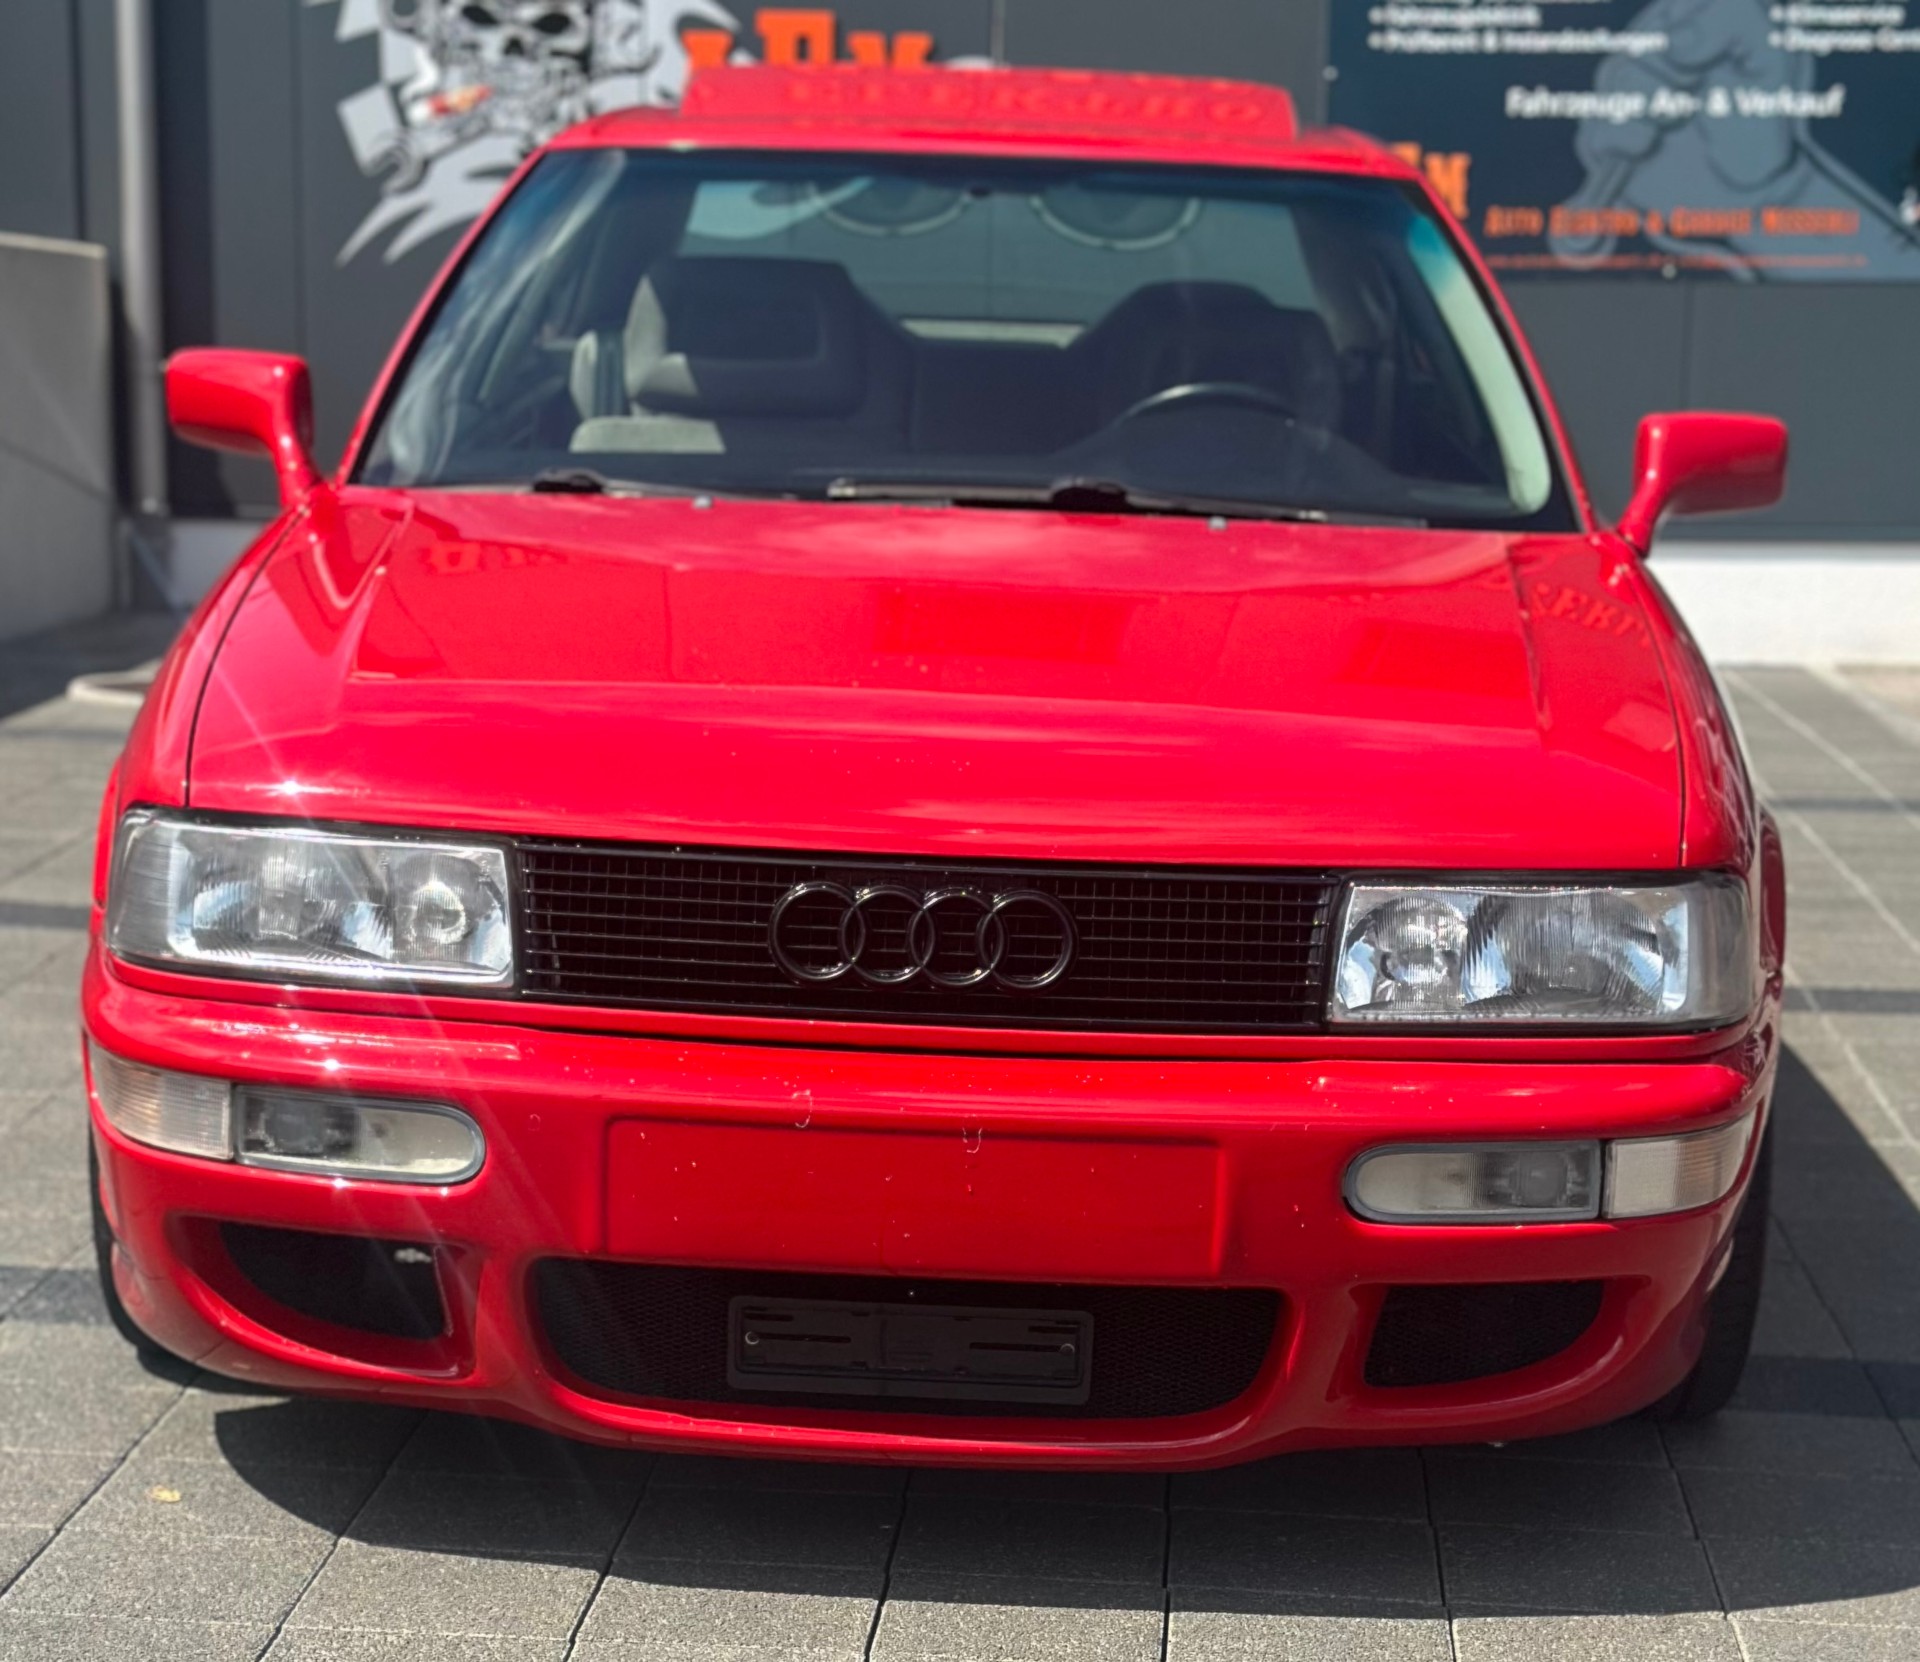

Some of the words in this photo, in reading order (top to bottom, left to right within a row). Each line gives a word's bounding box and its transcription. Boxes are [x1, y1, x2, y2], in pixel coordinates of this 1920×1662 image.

[1506, 86, 1646, 123] Fahrzeuge
[1707, 87, 1731, 117] &
[1734, 84, 1844, 118] Verkauf
